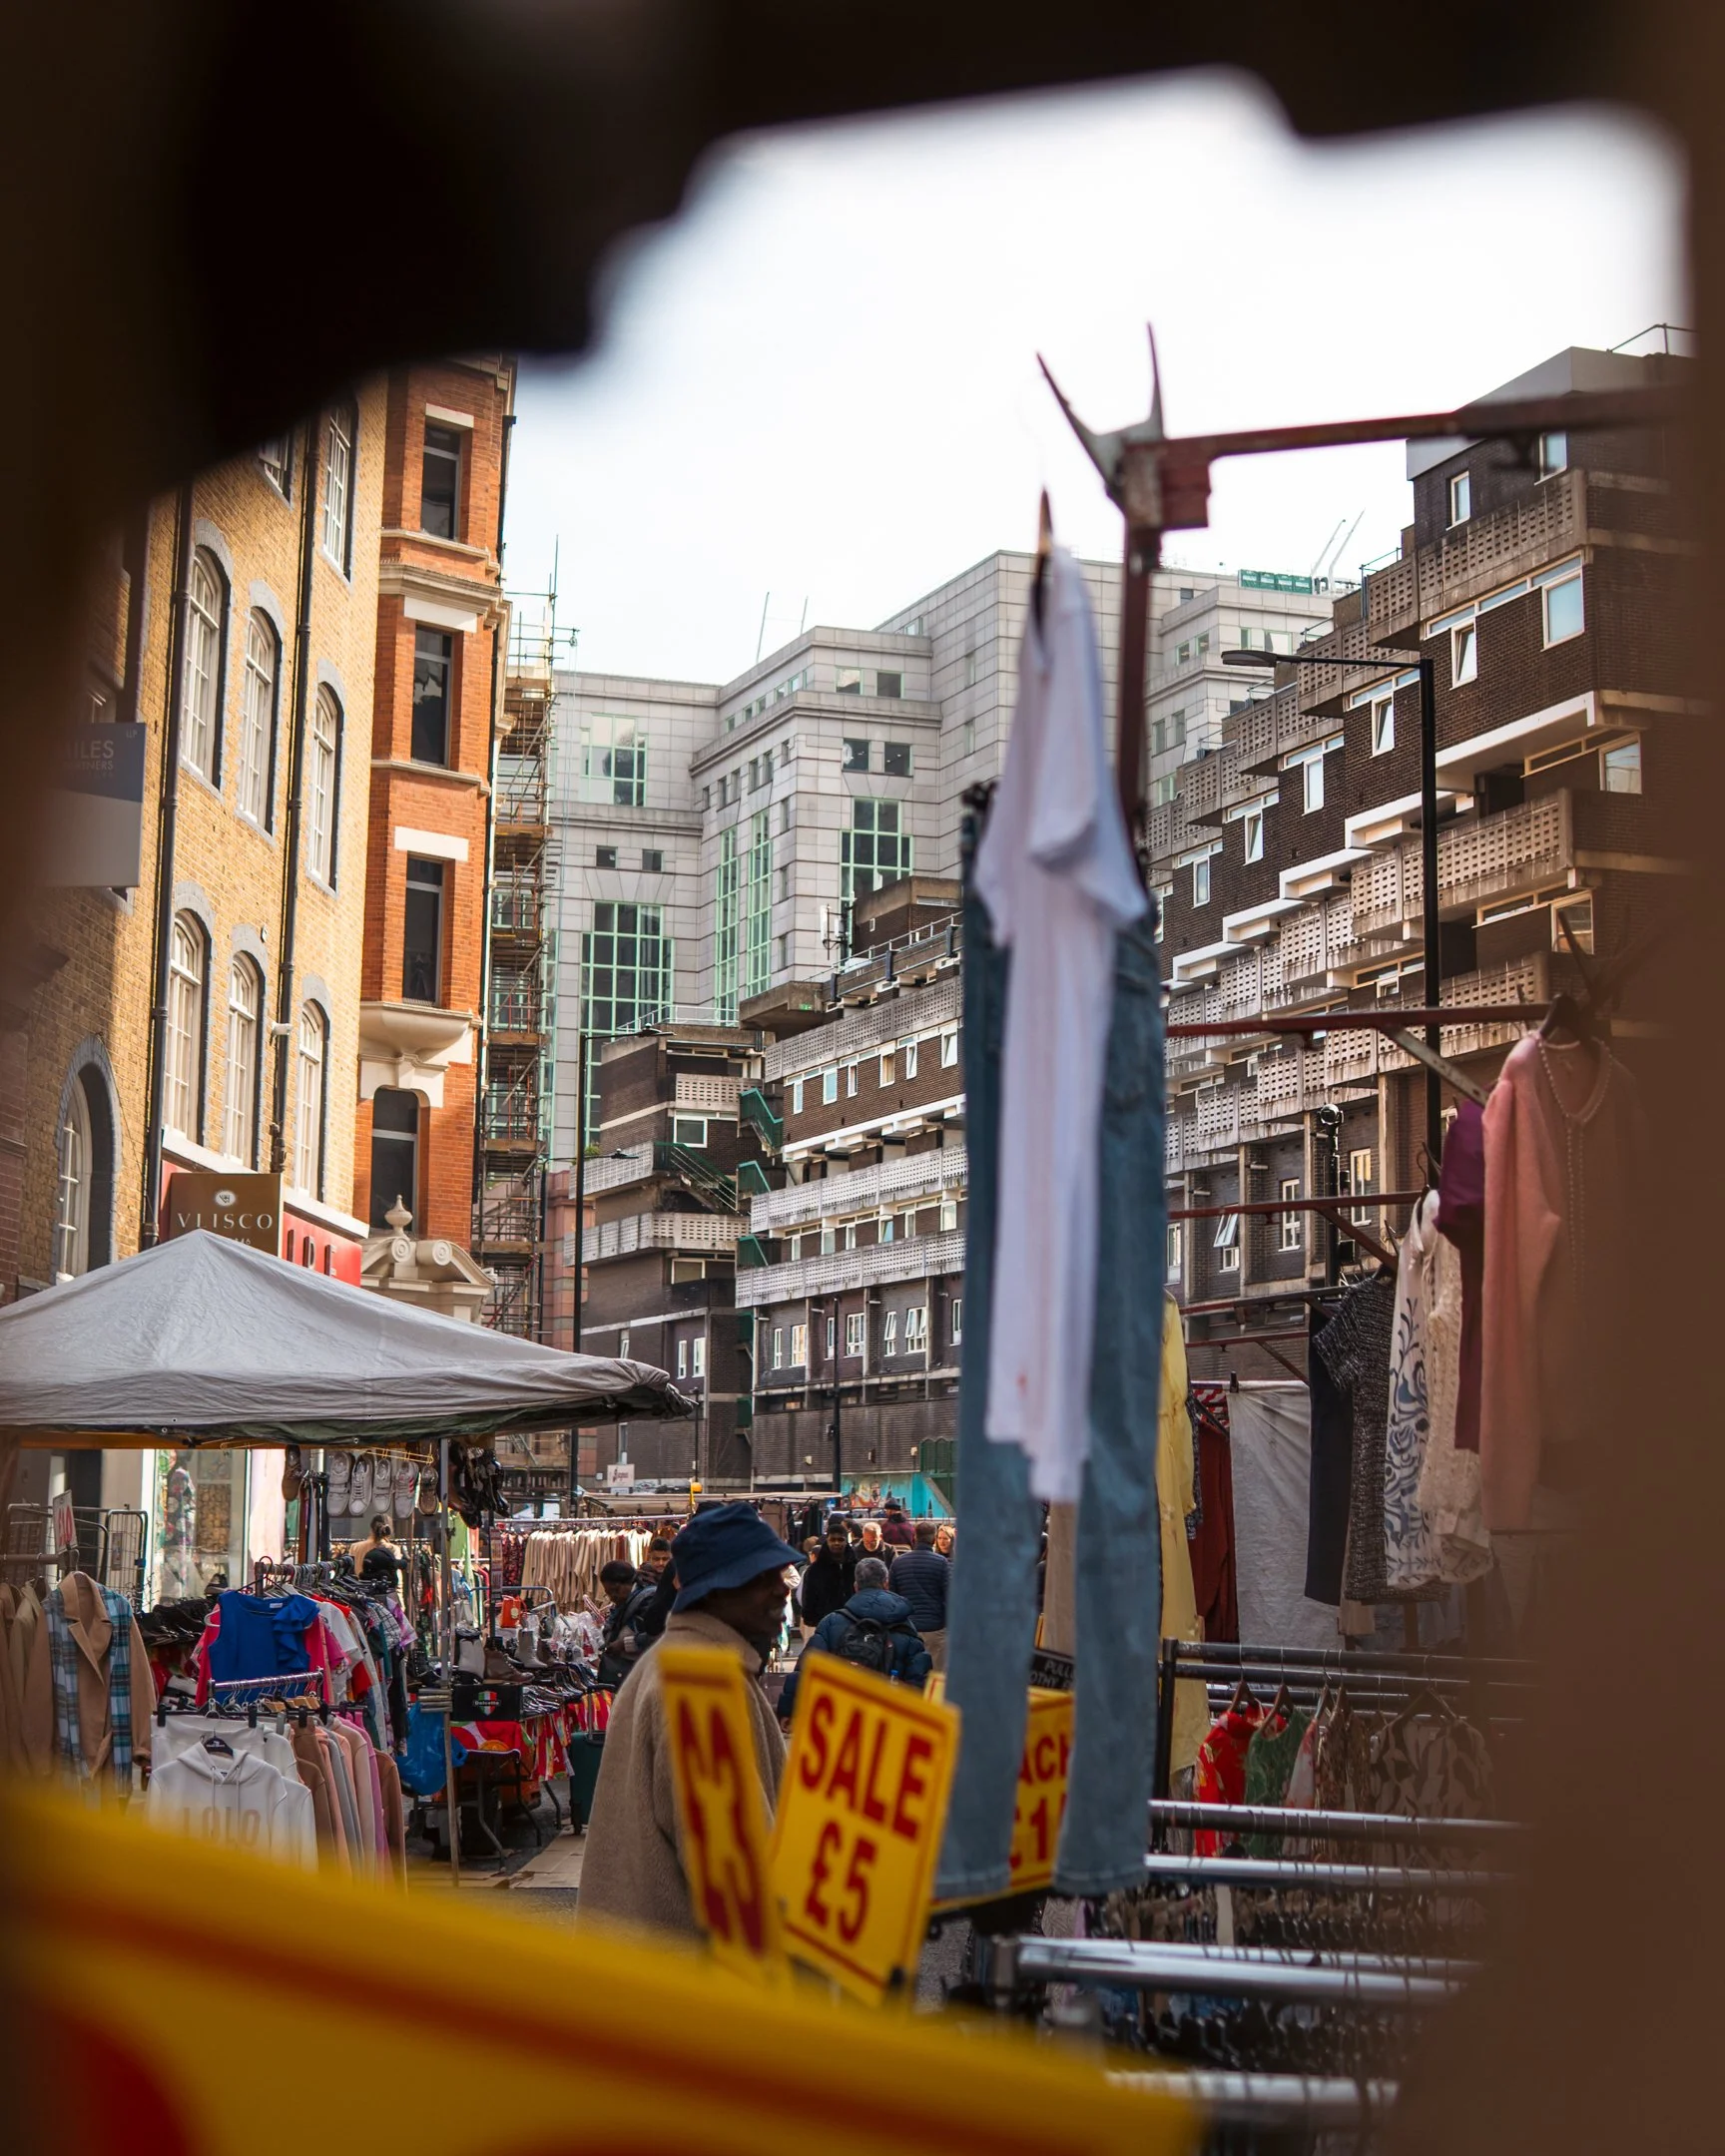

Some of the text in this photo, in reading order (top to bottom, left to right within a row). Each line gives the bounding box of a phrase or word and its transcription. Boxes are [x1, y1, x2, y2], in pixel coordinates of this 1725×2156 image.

[177, 1213, 274, 1230] VLISCO
[1044, 1659, 1074, 1679] PULL
[800, 1693, 933, 1842] SALE
[805, 1820, 878, 1945] £5
